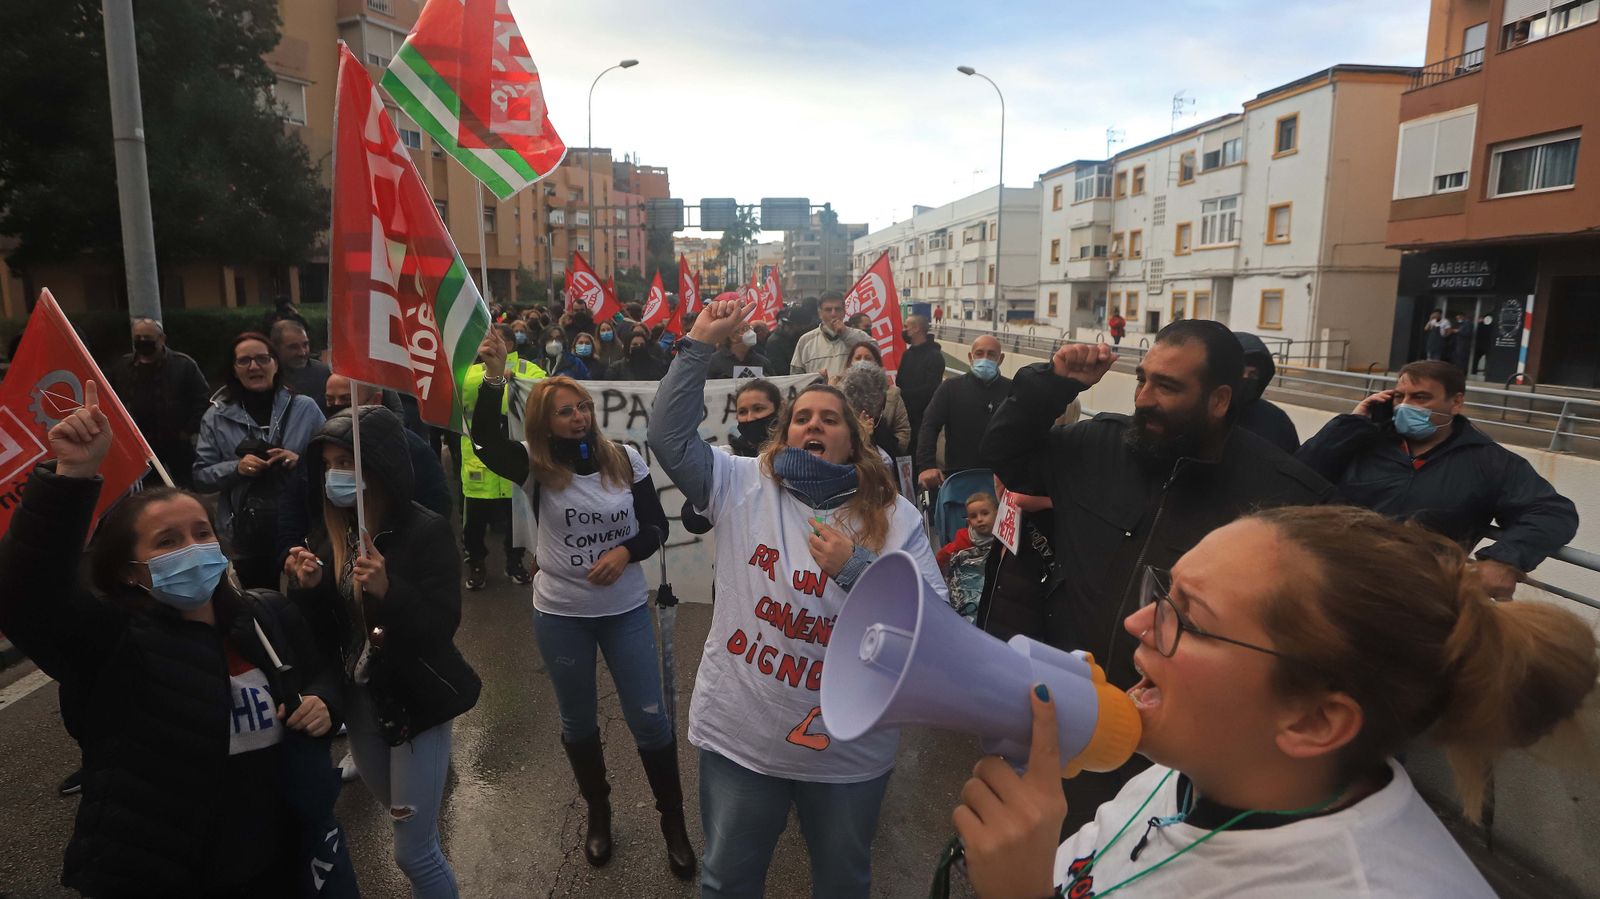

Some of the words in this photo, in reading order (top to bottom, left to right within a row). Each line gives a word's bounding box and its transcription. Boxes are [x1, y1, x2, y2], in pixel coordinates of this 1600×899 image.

[1430, 261, 1489, 275] BARBERIA
[1432, 277, 1483, 288] J.MORENO
[565, 508, 603, 527] POR
[611, 508, 629, 523] UN
[748, 544, 779, 582] POR
[792, 570, 829, 598] UN
